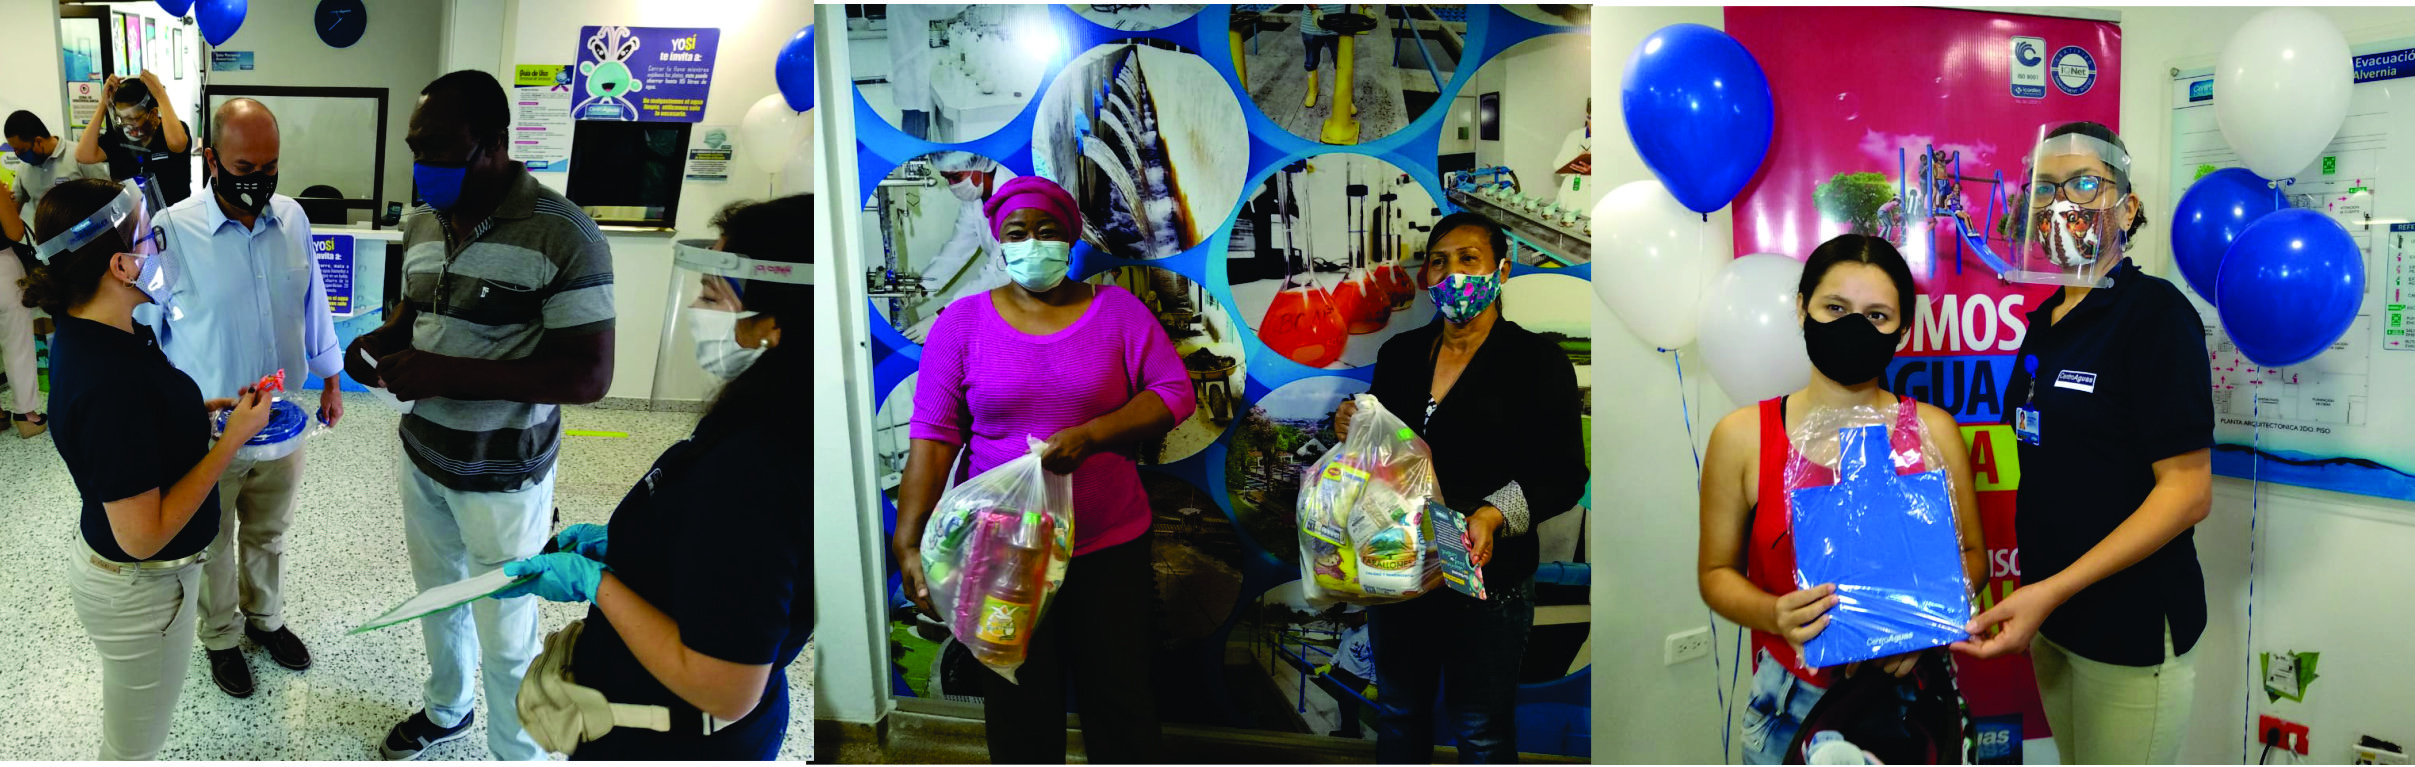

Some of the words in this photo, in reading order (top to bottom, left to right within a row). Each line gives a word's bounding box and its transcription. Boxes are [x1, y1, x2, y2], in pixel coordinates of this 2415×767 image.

[660, 52, 669, 61] te
[670, 52, 693, 61] invita
[2355, 49, 2415, 68] Evacuació
[2354, 66, 2397, 80] Alvernia
[317, 252, 334, 260] nvita
[1895, 294, 2027, 353] MOS
[1882, 360, 2001, 416] GUA
